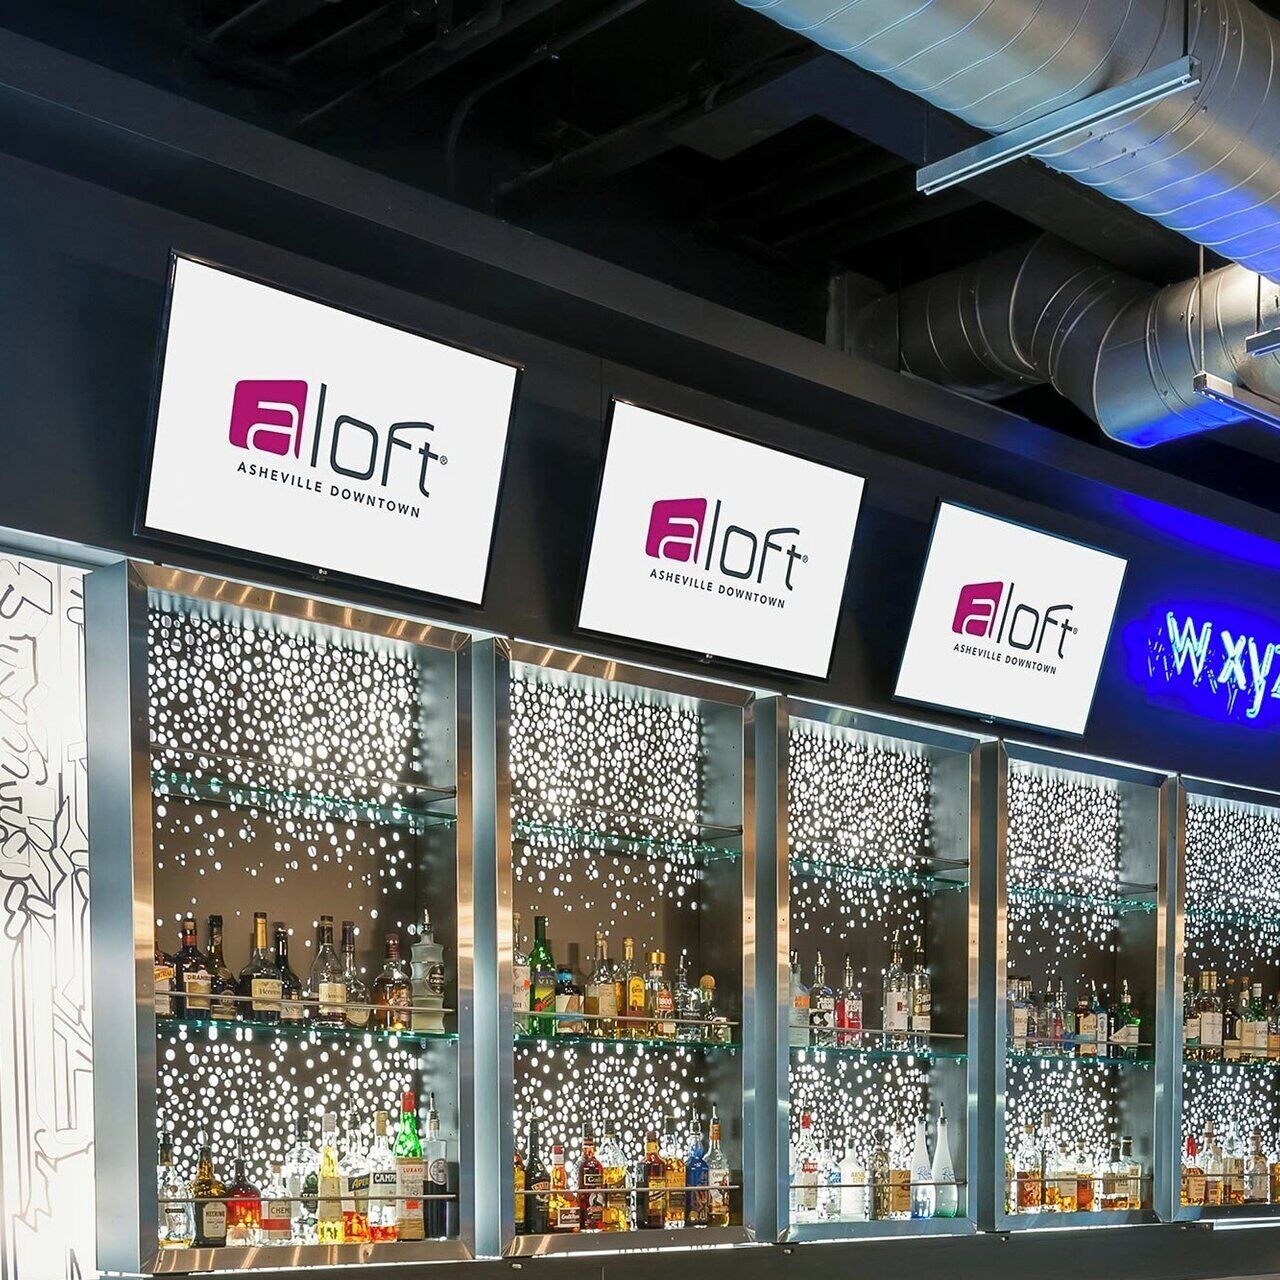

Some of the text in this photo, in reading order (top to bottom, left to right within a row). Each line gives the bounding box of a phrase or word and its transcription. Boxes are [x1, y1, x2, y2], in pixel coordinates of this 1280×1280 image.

[237, 462, 419, 518] ASHEVILLE DOWNTOWN
[650, 569, 784, 609] ASHEVILLE DOWNTOWN
[954, 643, 1056, 675] ASHEVILLE DOWNTOWN
